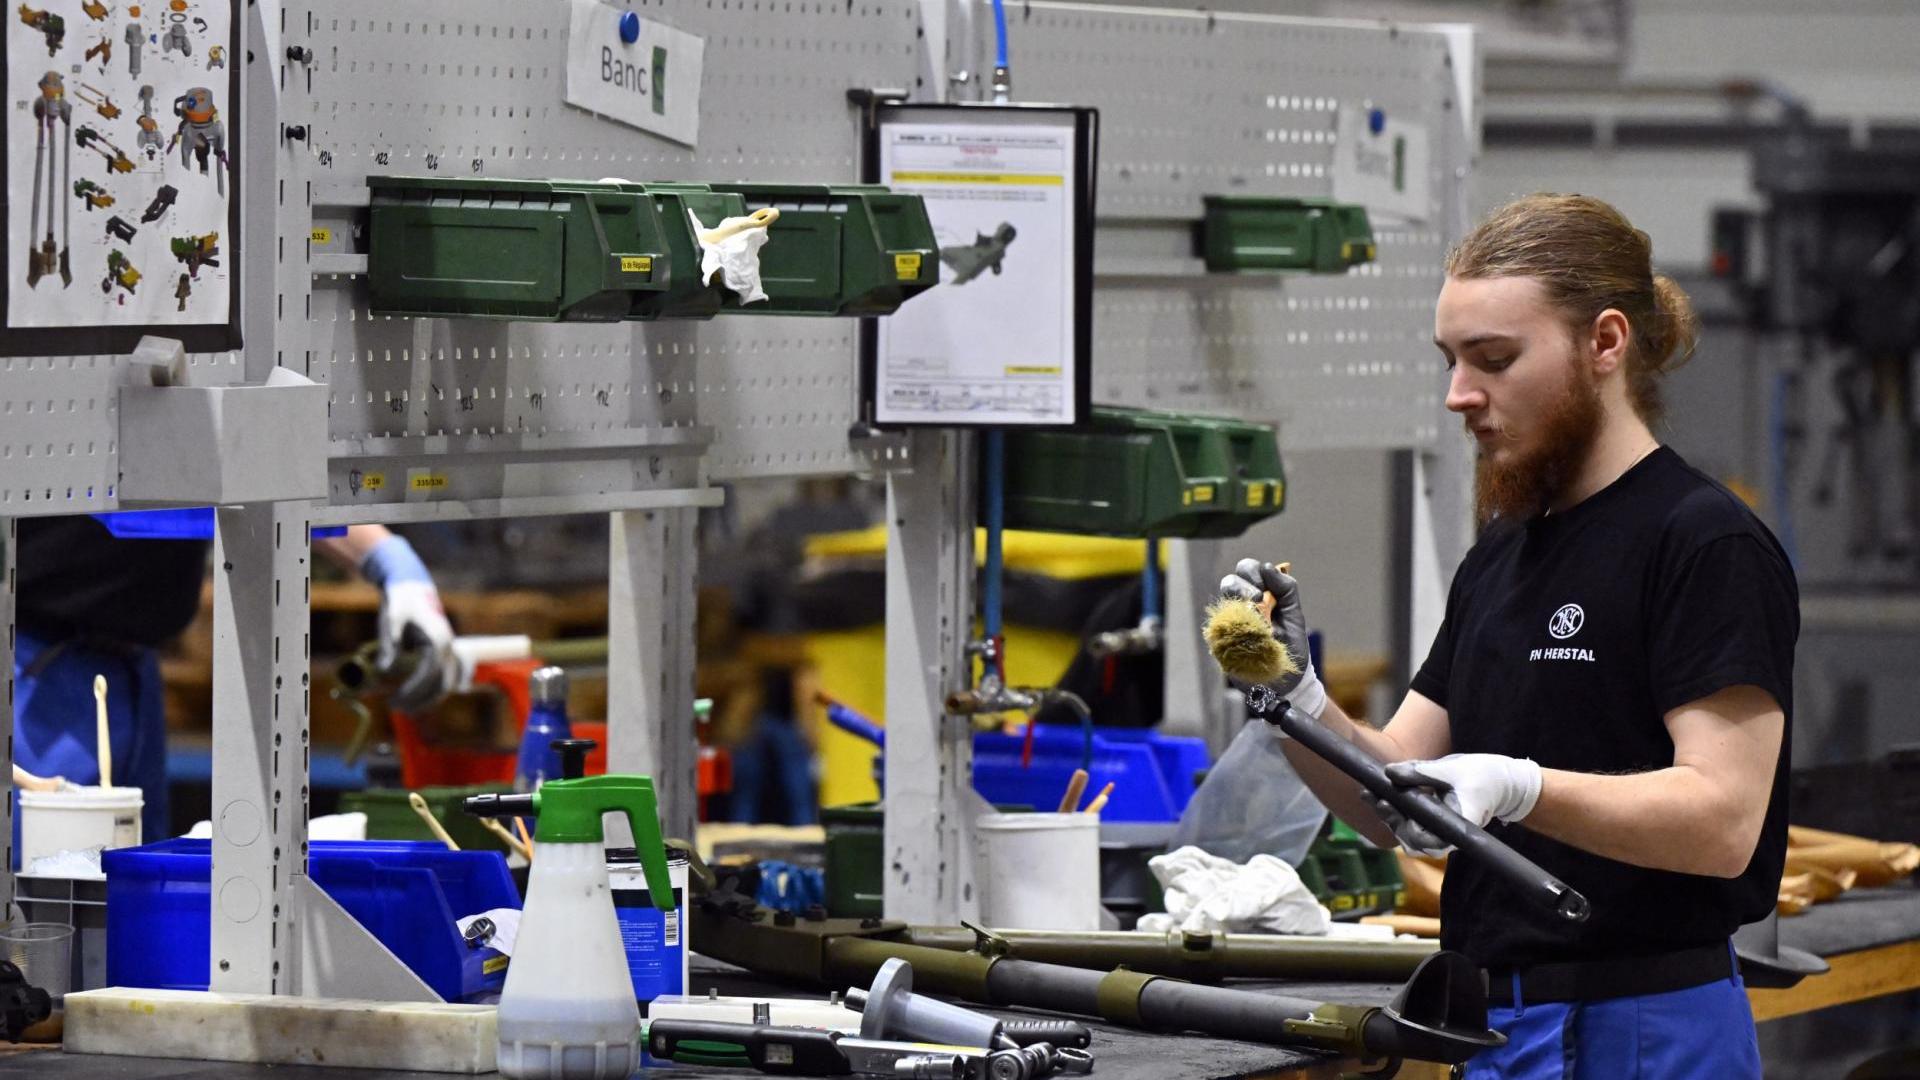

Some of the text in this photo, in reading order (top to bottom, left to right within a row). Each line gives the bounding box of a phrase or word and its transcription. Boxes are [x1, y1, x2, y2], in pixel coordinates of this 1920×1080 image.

[601, 45, 648, 96] Banc
[319, 150, 333, 169] 124
[375, 152, 389, 166] 122
[426, 152, 438, 170] 126
[1529, 647, 1596, 662] FN HERSTAL
